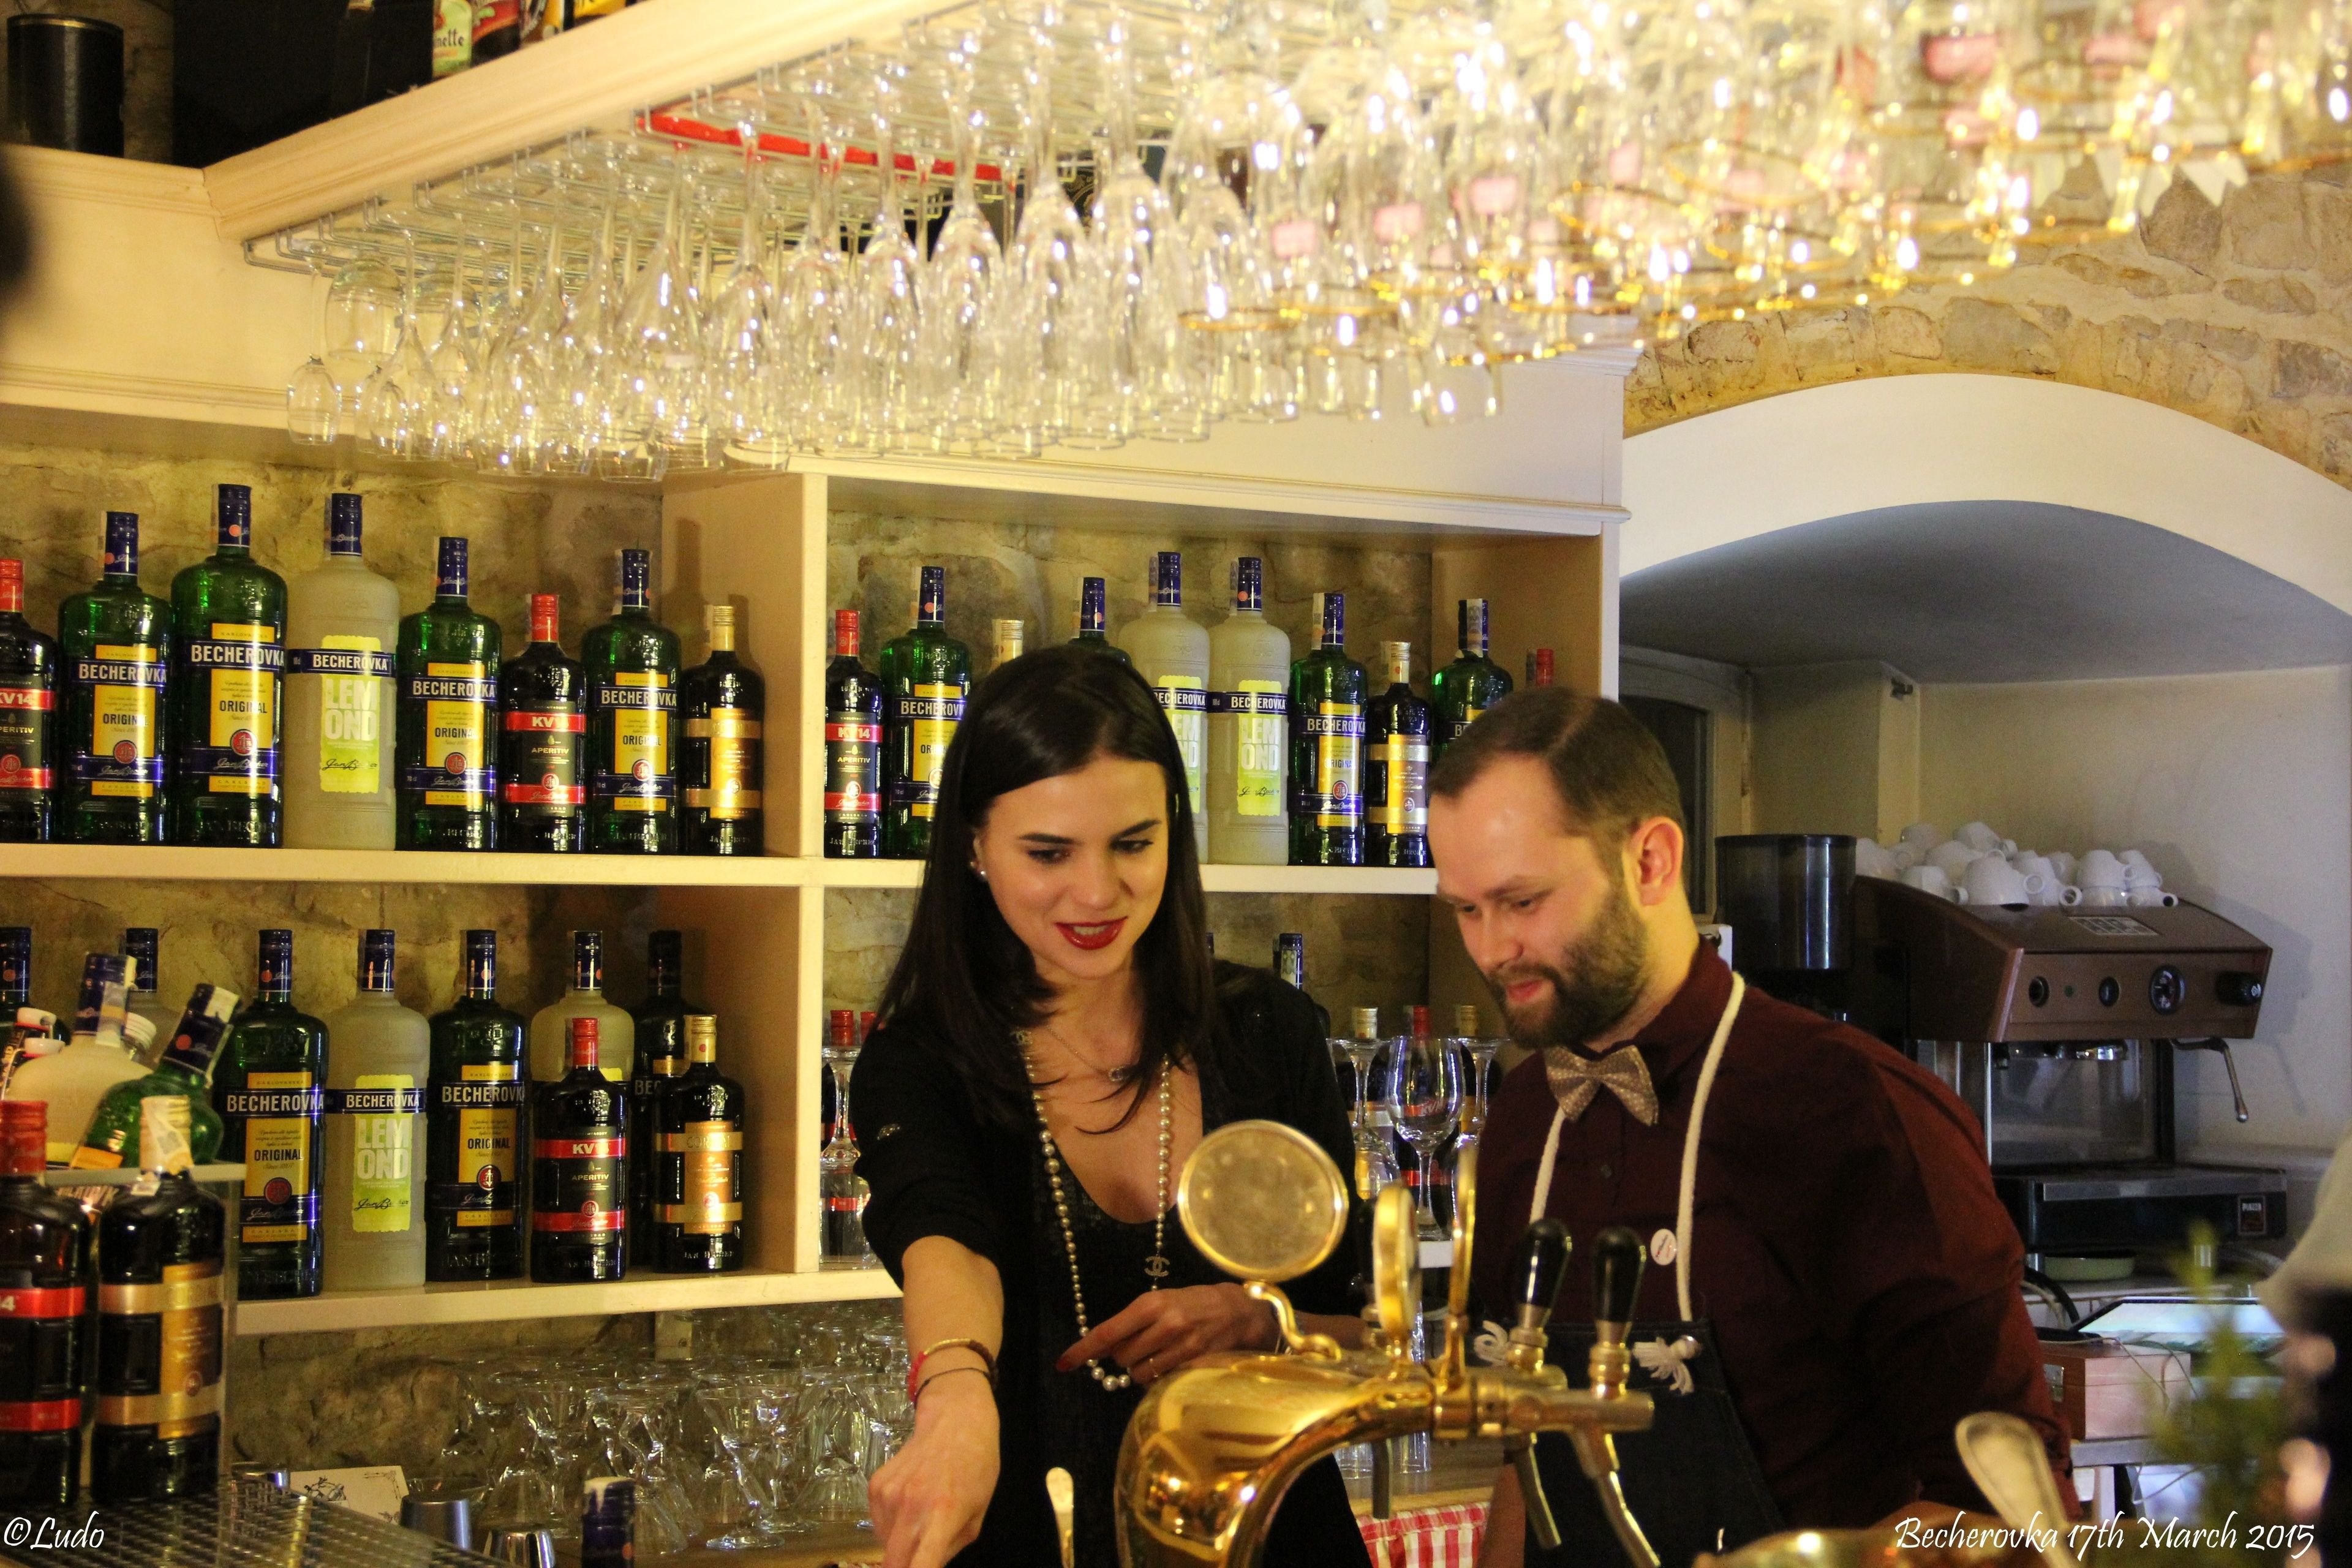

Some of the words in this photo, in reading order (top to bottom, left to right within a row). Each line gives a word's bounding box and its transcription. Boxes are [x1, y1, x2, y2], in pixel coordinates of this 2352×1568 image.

[191, 644, 284, 667] BECHEROVKA
[313, 654, 388, 671] BECHEROVKA
[78, 663, 167, 683] BECHEROVKA
[326, 679, 377, 710] LEM
[412, 680, 496, 698] BECHEROVKA
[0, 693, 35, 705] V14
[601, 690, 677, 706] BECHEROVKA
[1231, 696, 1286, 710] BECHEROVKA
[219, 700, 268, 714] ORIGIAL
[900, 701, 965, 716] BECHEROV
[103, 713, 149, 726] ORIGINL
[325, 709, 377, 741] OND
[532, 716, 569, 728] KV
[1172, 714, 1199, 739] EM
[1307, 718, 1366, 733] BECHEROVKA
[434, 727, 478, 739] ORIGINA
[1242, 717, 1280, 745] LEM
[622, 735, 662, 745] ORIGAL
[1241, 744, 1279, 771] OND
[346, 1094, 420, 1108] BECHEROVKA
[442, 1086, 525, 1102] BECHEROVK
[227, 1095, 325, 1112] BECHEROVKA
[358, 1118, 409, 1148] LEM
[467, 1137, 511, 1149] ORIGINAL
[572, 1142, 609, 1155] KV
[254, 1148, 304, 1161] ORIGINAL
[356, 1148, 409, 1180] OND
